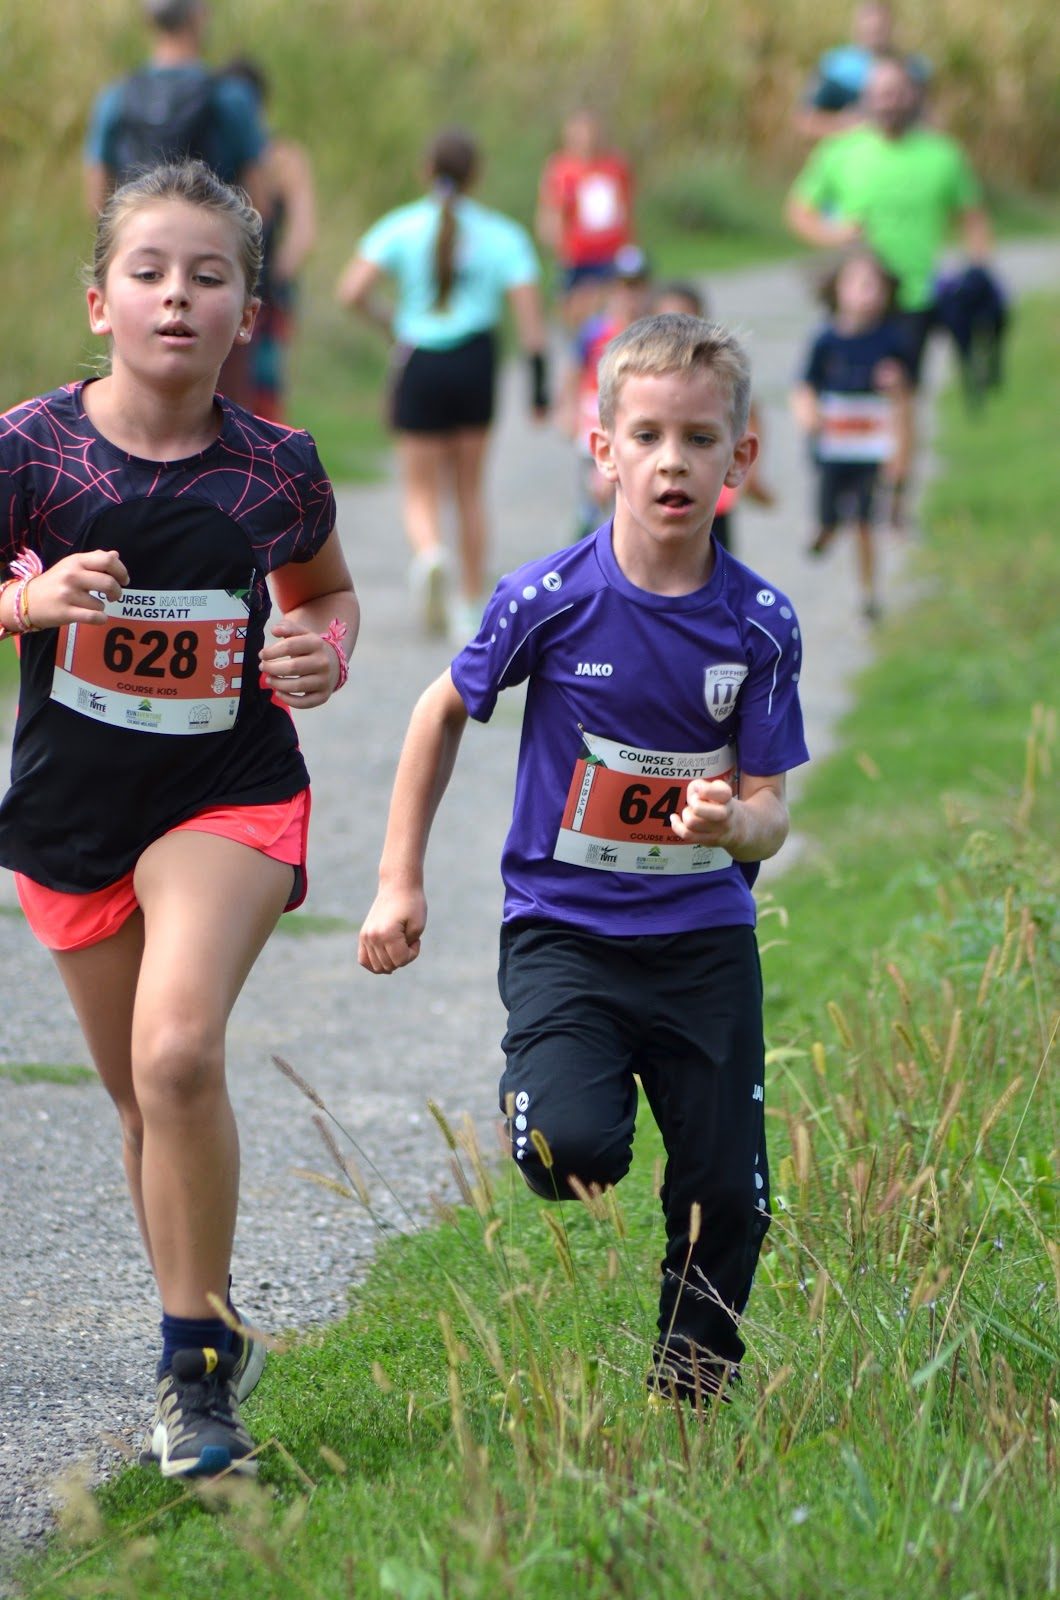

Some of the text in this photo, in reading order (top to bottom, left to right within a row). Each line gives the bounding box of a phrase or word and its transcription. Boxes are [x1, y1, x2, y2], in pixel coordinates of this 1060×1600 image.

[98, 591, 208, 607] CURSES NATURE
[122, 607, 191, 619] MAGSTATT
[103, 626, 199, 680] 628
[574, 662, 614, 677] JAKO
[116, 682, 178, 697] COURSE KIDS
[618, 749, 674, 766] COURSES
[640, 766, 706, 778] MAGSTATT
[619, 783, 688, 828] 64
[630, 833, 685, 842] COURSE KID
